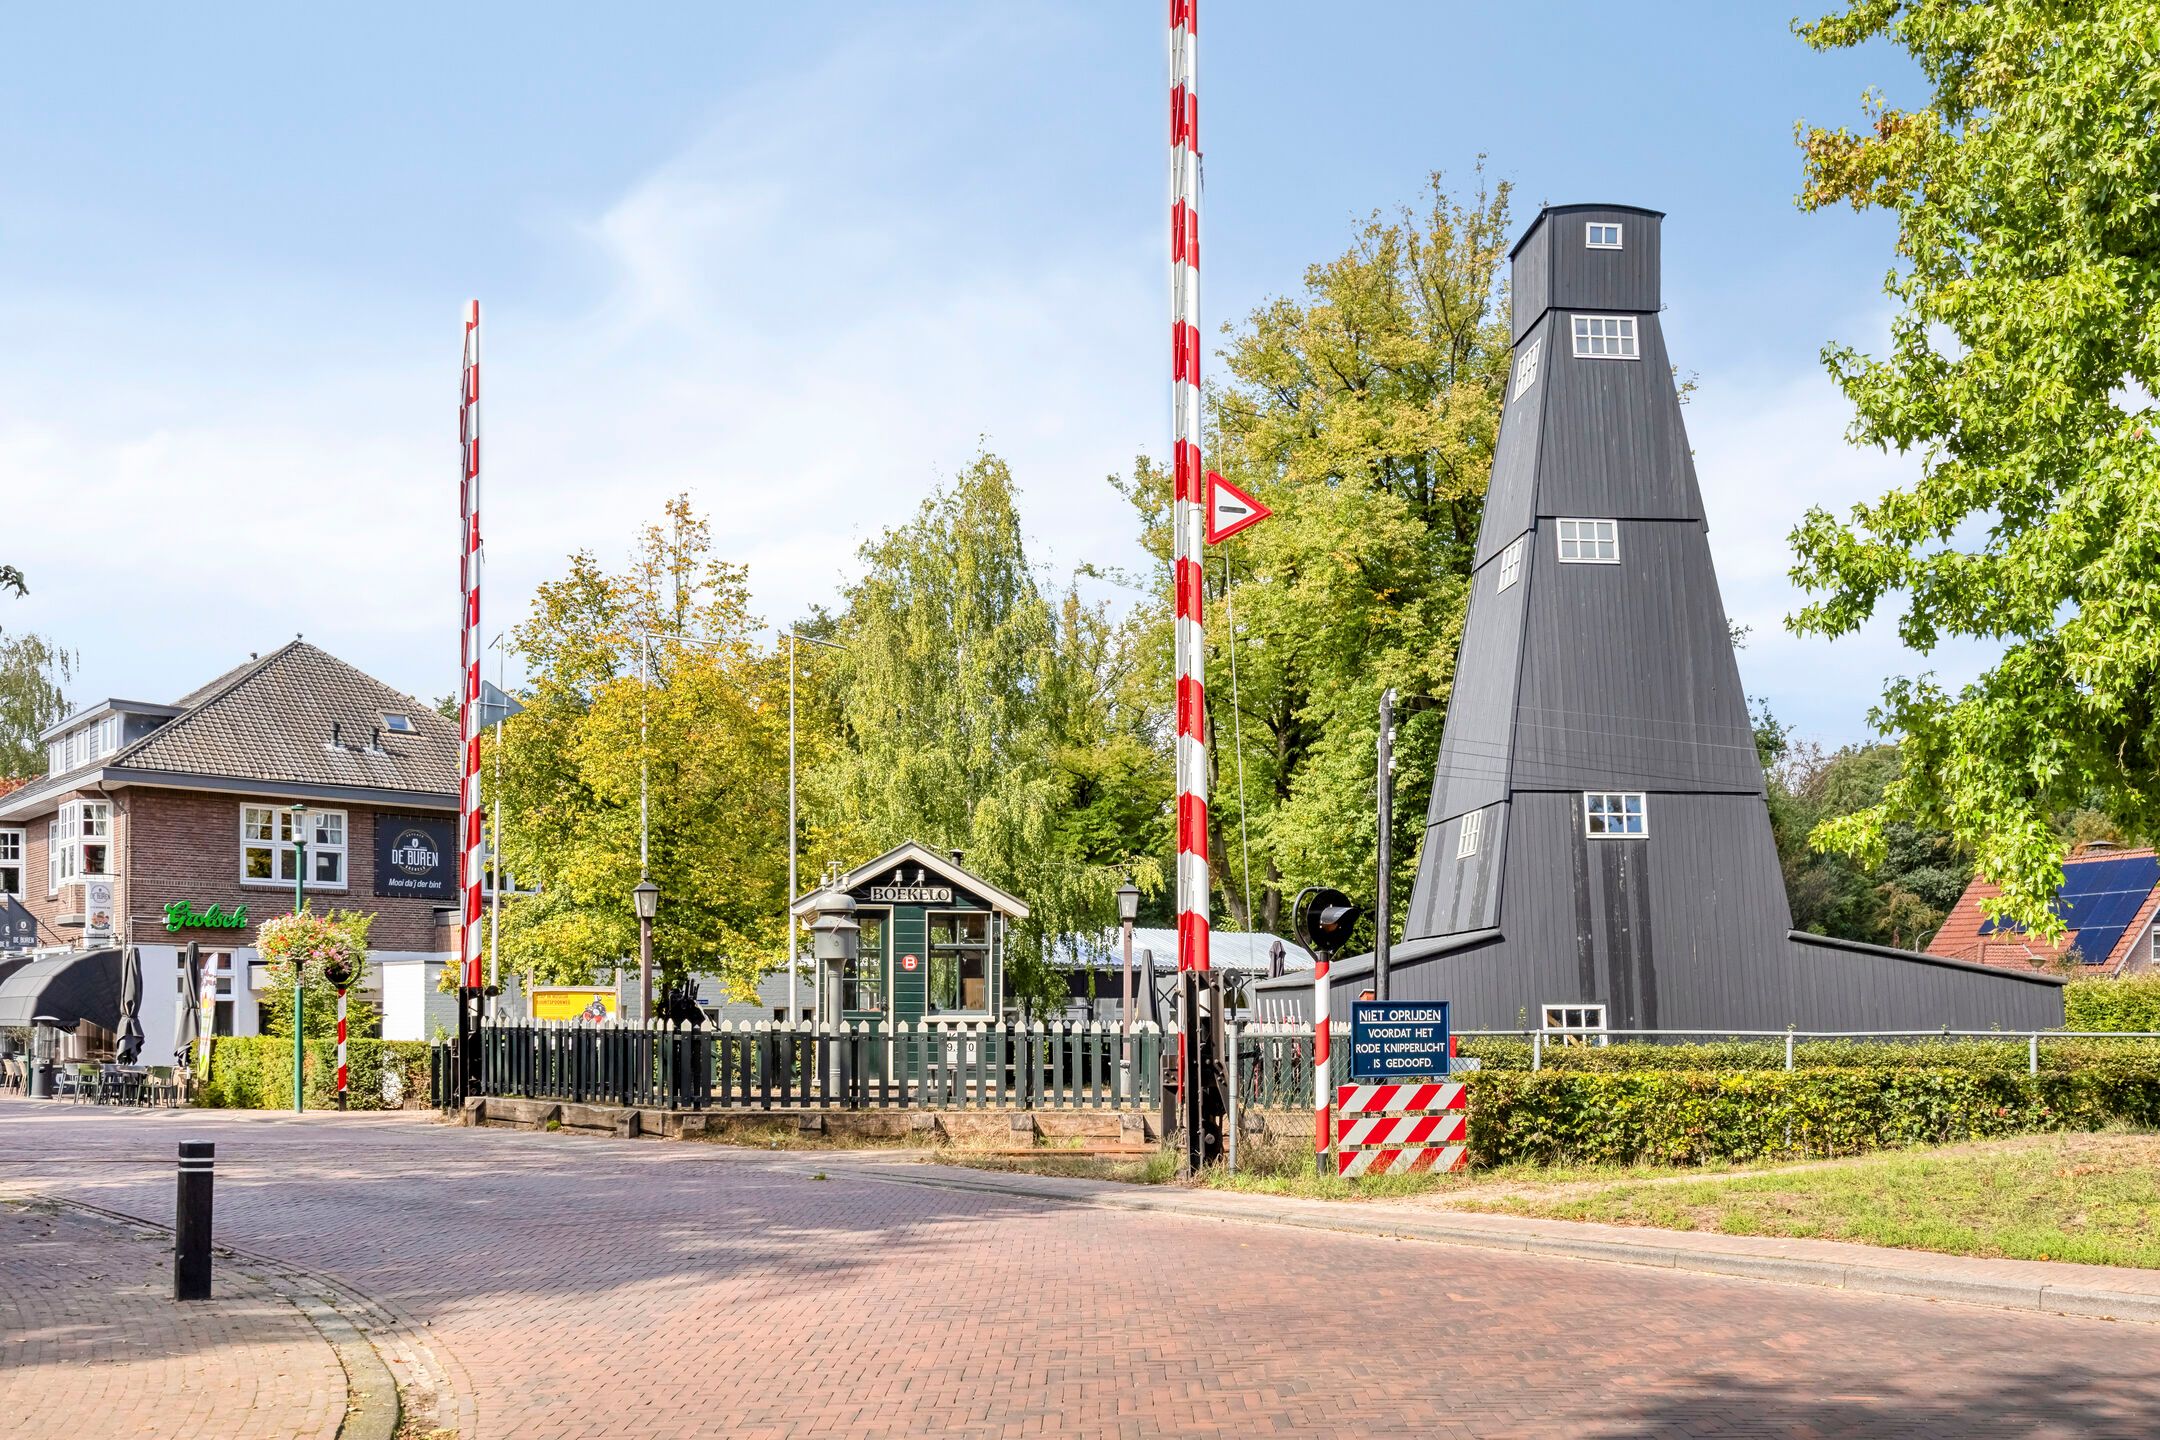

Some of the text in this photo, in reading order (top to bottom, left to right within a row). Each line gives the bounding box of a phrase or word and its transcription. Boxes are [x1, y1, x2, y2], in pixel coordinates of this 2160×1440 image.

[391, 849, 439, 867] DE BUREN
[388, 878, 404, 887] Mooi
[428, 880, 442, 889] bint
[872, 887, 950, 901] BOEKELO
[164, 900, 248, 932] Grolsch
[905, 957, 915, 969] B
[1389, 1009, 1441, 1022] OPRIJDEN
[1368, 1028, 1433, 1038] VOORDAT HET
[947, 1042, 975, 1052] 9.0
[1355, 1042, 1445, 1054] RODE KNIPPERLICHT
[1373, 1058, 1381, 1069] IS
